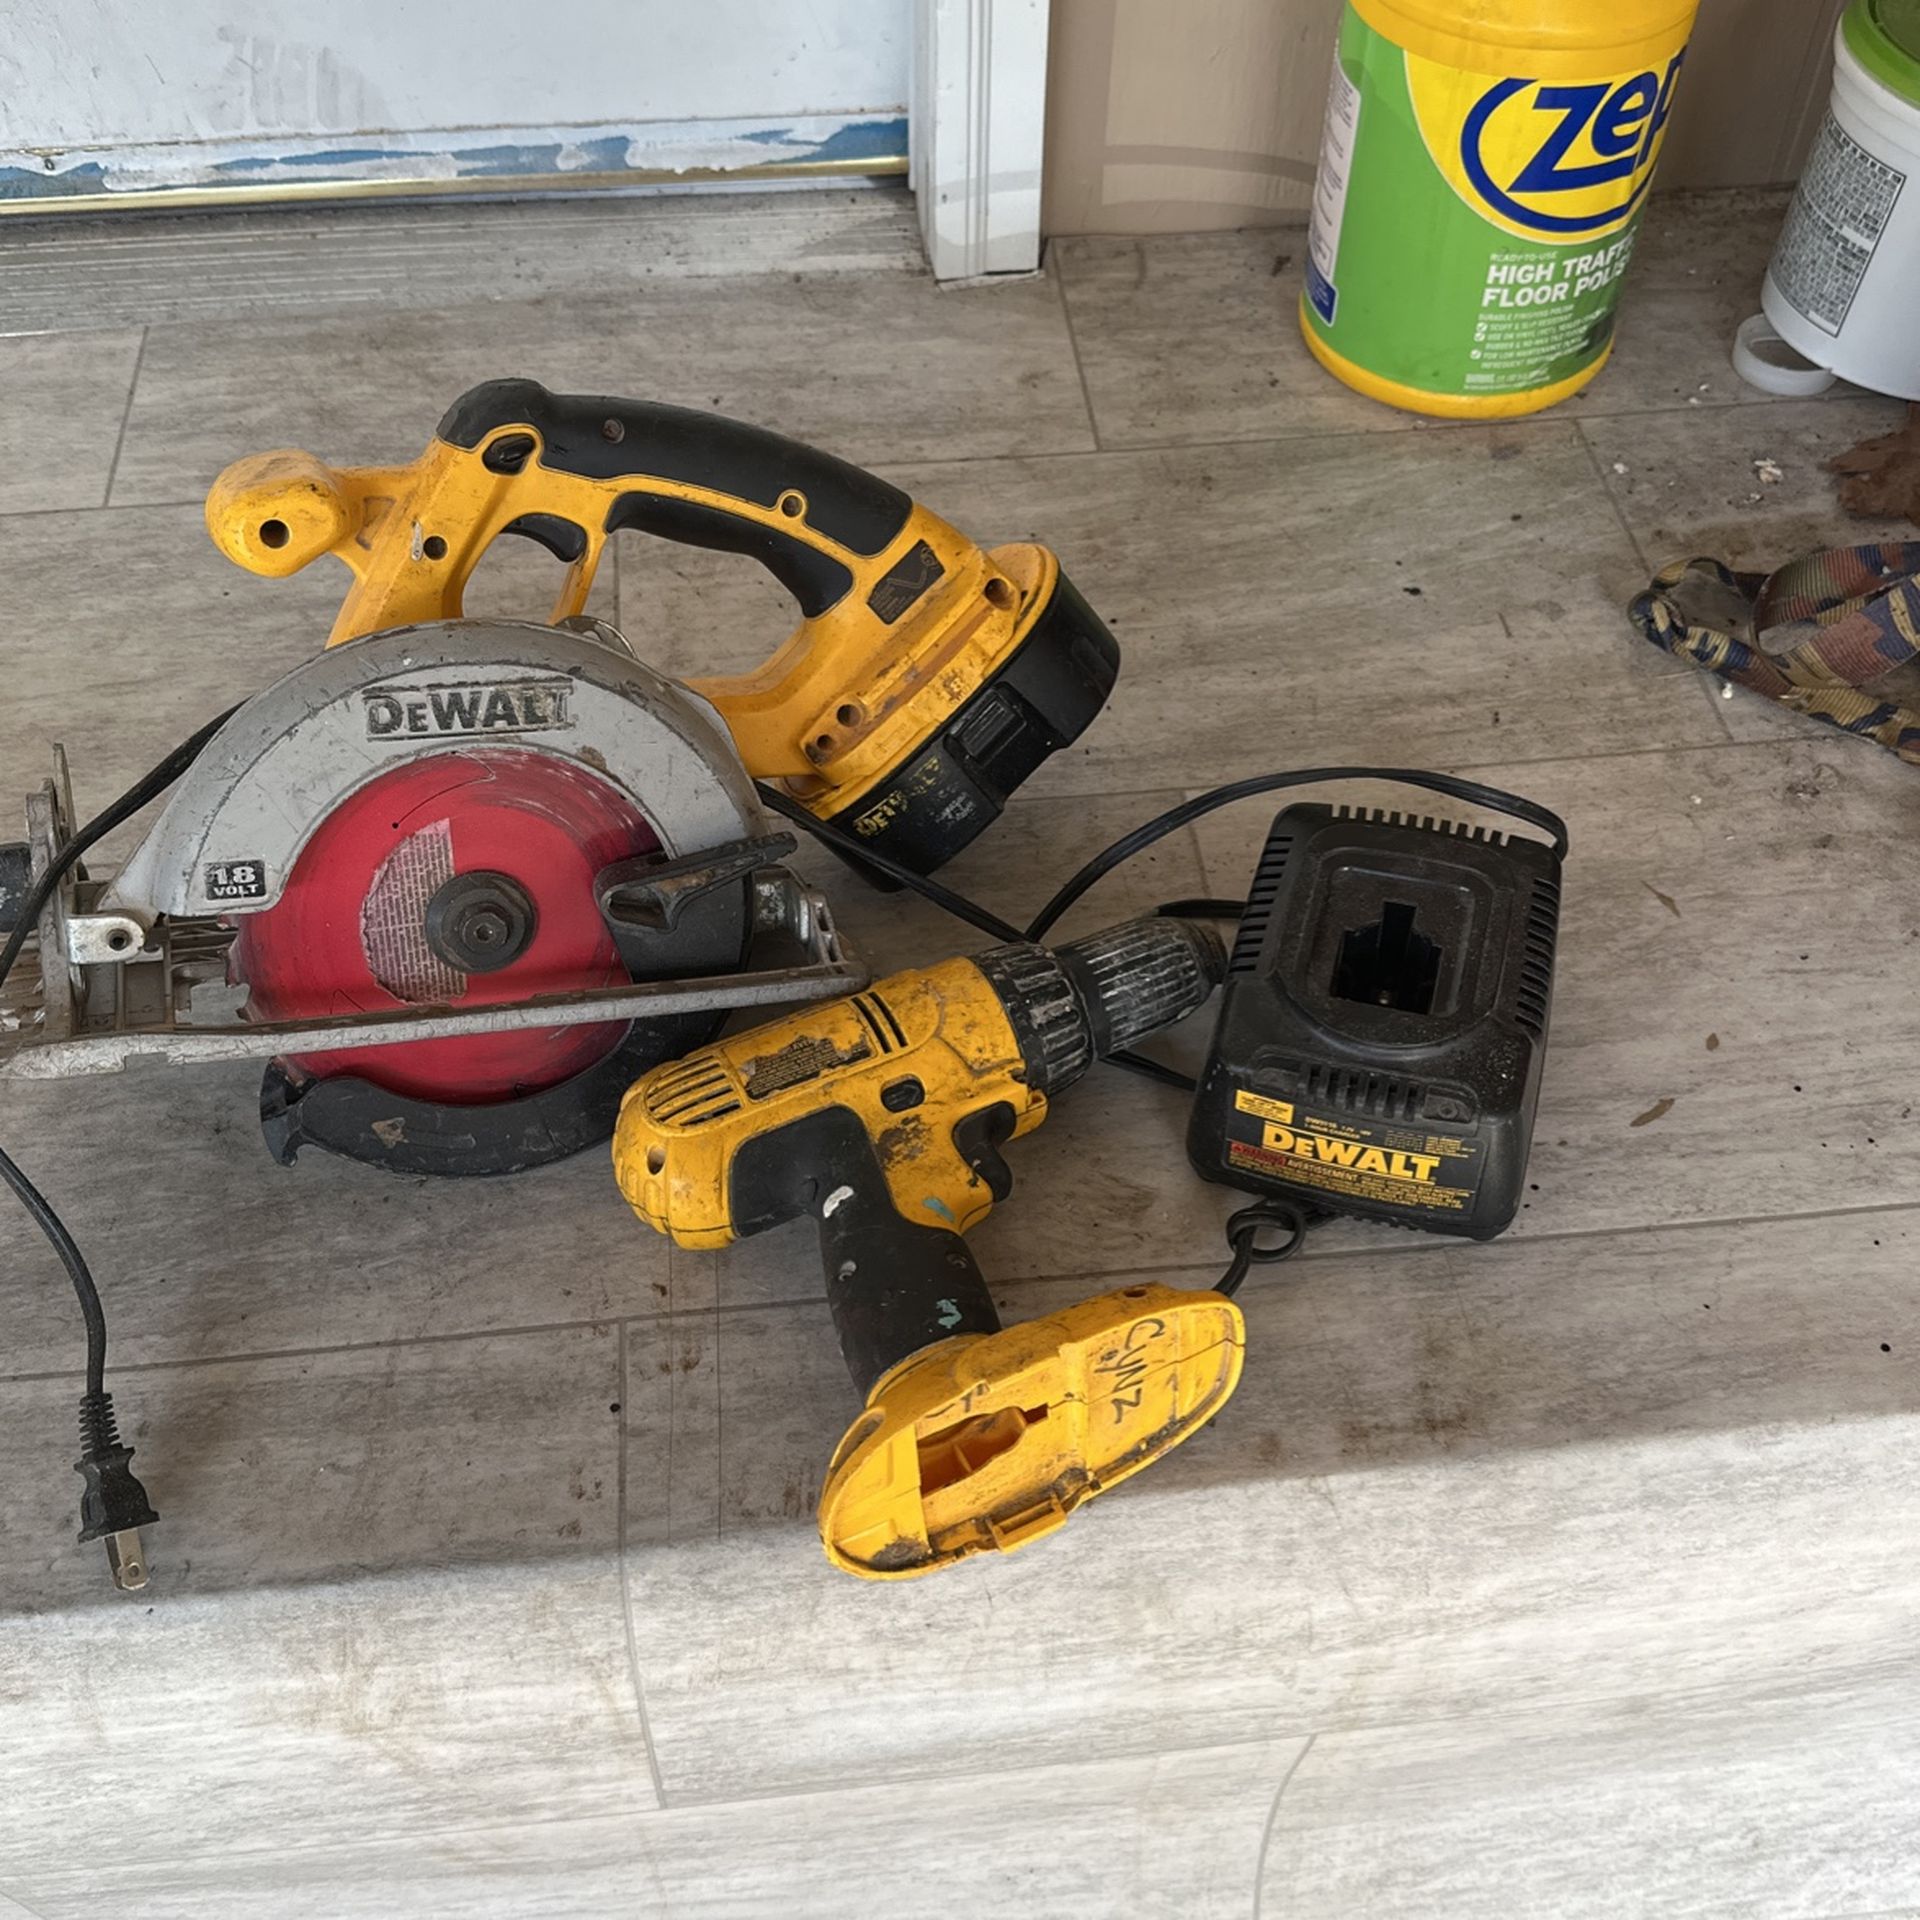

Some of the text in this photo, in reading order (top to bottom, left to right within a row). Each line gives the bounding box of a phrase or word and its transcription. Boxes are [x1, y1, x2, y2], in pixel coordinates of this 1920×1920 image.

[1486, 262, 1555, 285] HIGH
[1481, 282, 1570, 307] FLOOR
[214, 866, 256, 885] 18
[213, 883, 259, 897] VOLT
